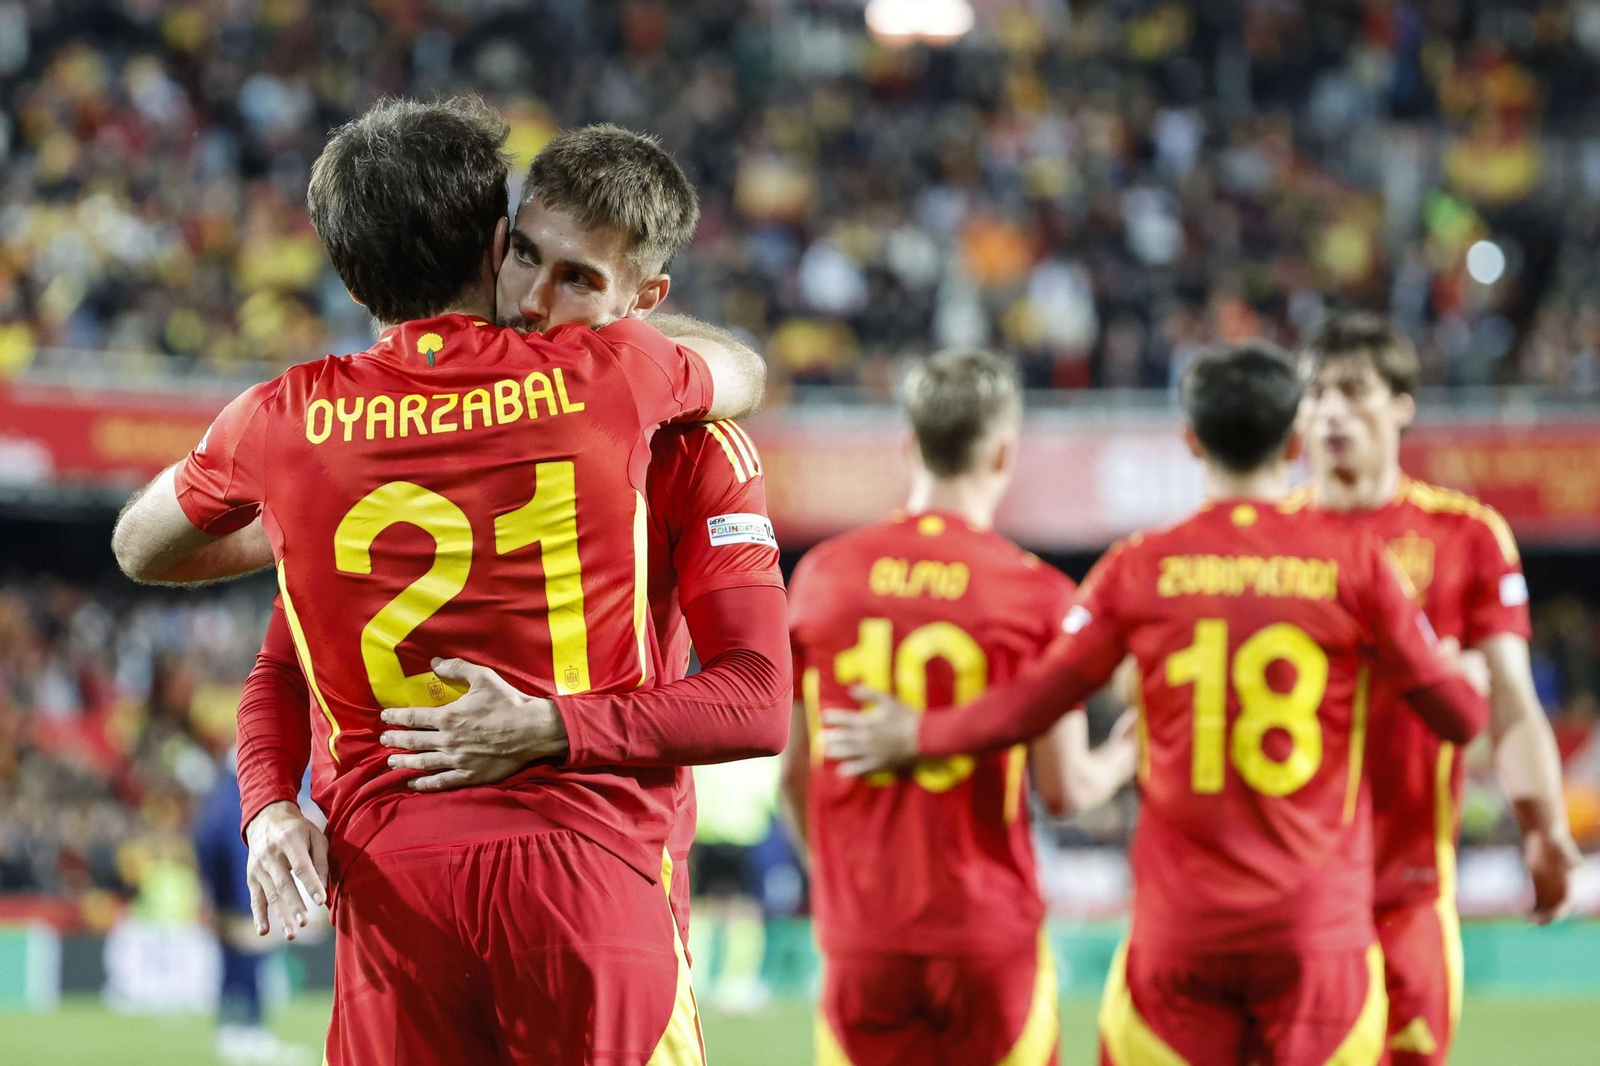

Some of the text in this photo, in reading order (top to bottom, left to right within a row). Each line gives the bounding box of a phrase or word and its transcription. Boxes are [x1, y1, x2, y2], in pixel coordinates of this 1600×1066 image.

[306, 368, 585, 446] OYARZABAL
[709, 518, 726, 526] UEFA
[334, 461, 591, 708] 21
[869, 556, 970, 600] OLMO
[1166, 617, 1330, 797] 18
